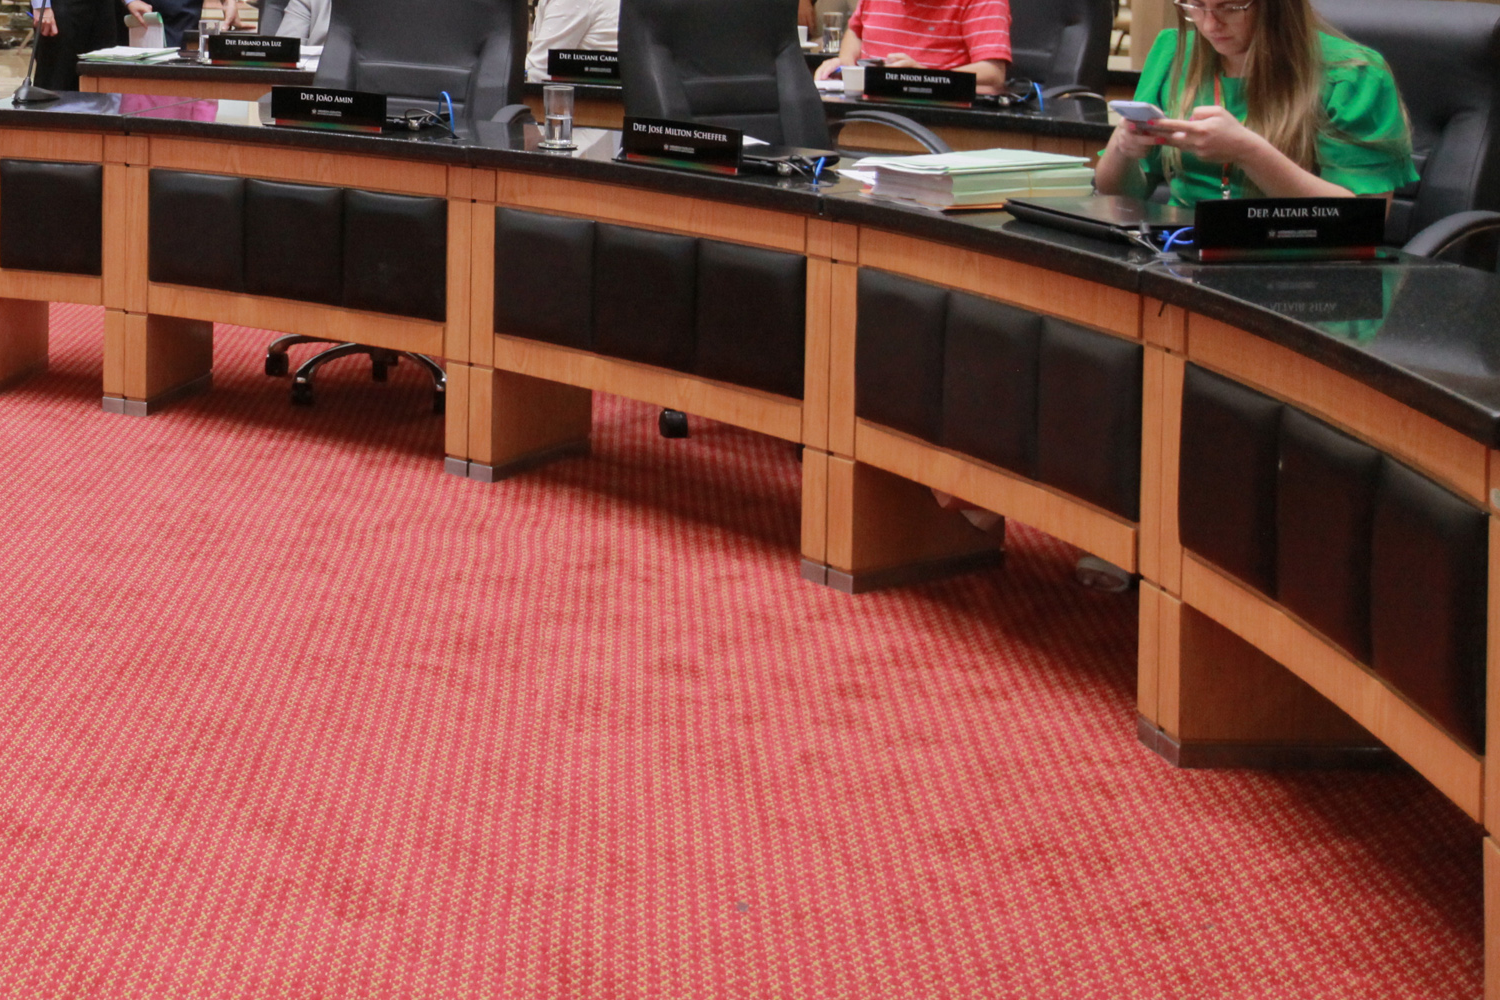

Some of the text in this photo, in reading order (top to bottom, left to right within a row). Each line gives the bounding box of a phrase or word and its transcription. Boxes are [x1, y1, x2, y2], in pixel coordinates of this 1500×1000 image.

[573, 53, 598, 61] LUCIANE
[900, 73, 922, 82] NEODI
[923, 75, 951, 84] SARETTA
[315, 93, 333, 103] JOÃO
[334, 95, 353, 104] AMIN
[648, 124, 663, 134] JOSÉ
[664, 127, 692, 138] MILTON
[693, 130, 728, 142] SCHEFFER
[1247, 206, 1339, 218] DEP. ALTAIR SILVA
